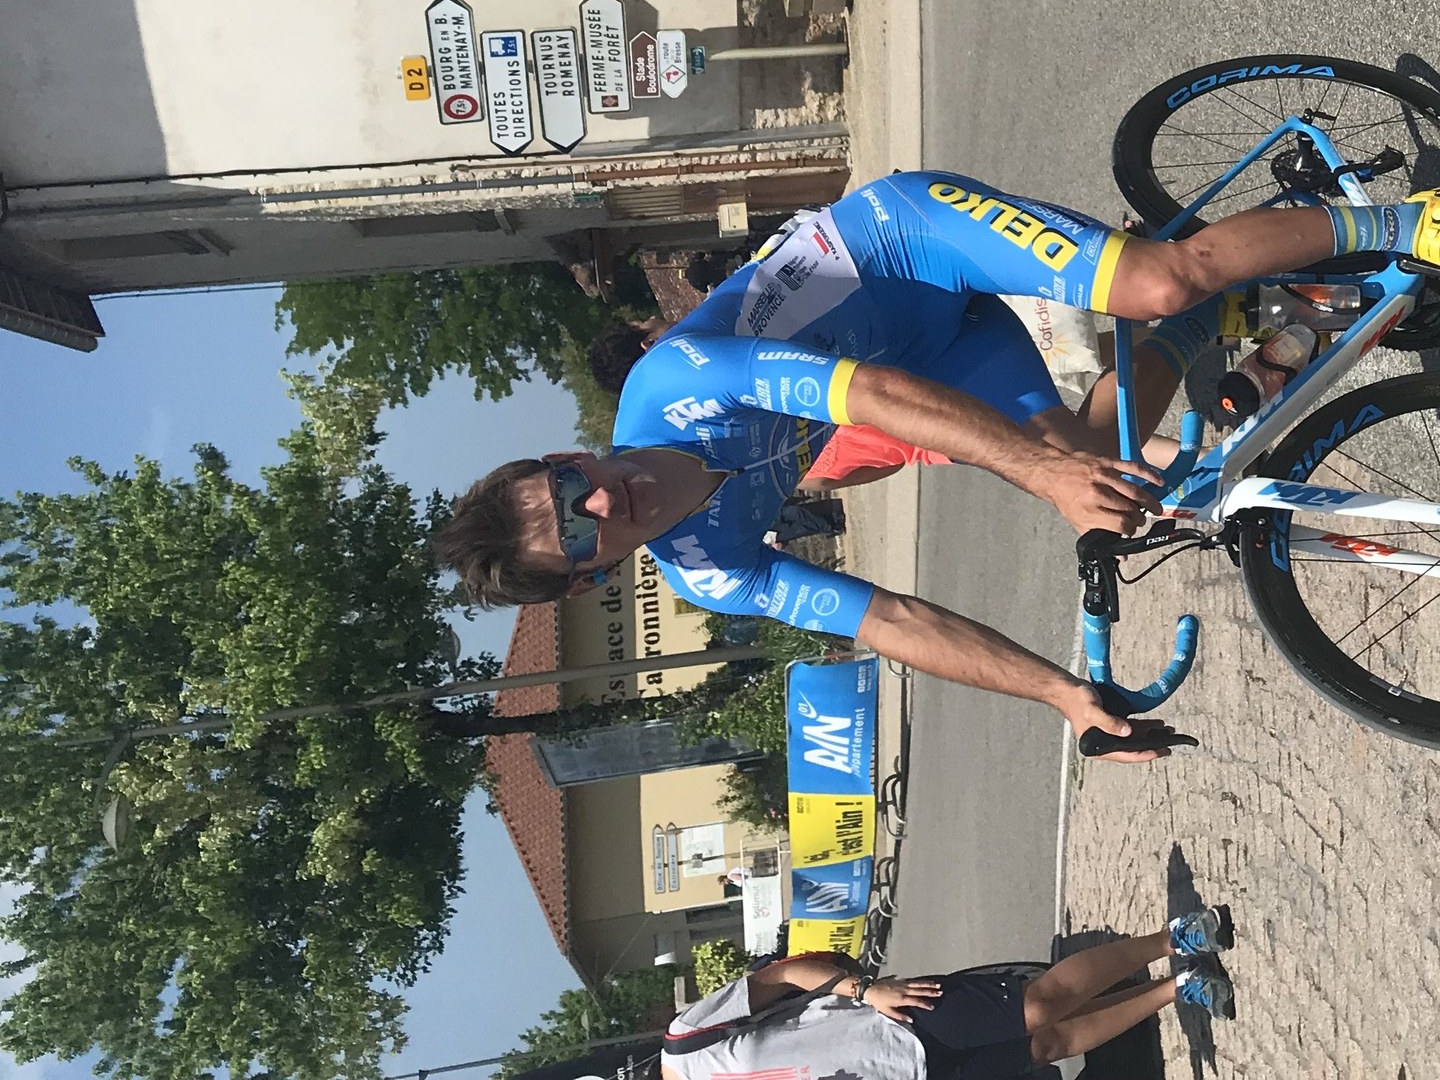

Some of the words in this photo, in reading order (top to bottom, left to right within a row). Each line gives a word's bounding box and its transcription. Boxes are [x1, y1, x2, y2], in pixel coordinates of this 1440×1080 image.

[434, 13, 448, 24] B.
[441, 30, 450, 41] EN
[452, 13, 473, 89] MANTENAY-M.
[539, 35, 558, 96] TOURNUS
[556, 35, 575, 96] ROMENAY
[586, 9, 606, 92] FERME-MUSÉE
[604, 25, 620, 62] FORÊT
[407, 68, 422, 76] 2
[409, 82, 424, 90] D
[438, 46, 456, 90] BOURG
[614, 69, 622, 78] LA
[615, 82, 623, 92] DE
[635, 57, 646, 82] Stade
[646, 44, 657, 93] Boulodrome
[1166, 64, 1336, 108] CORIMA
[494, 91, 509, 138] TOUTES
[507, 60, 526, 138] DIRECTIONS
[860, 188, 890, 221] poli
[928, 182, 1080, 272] DELKO
[747, 283, 774, 327] MARSEILLE
[1034, 298, 1054, 351] Cofidis
[669, 338, 710, 368] poli
[756, 351, 830, 364] SRAM
[780, 377, 788, 412] rovence
[671, 534, 742, 600] KTM
[600, 585, 622, 613] de
[634, 552, 663, 698] Caronnière
[601, 622, 626, 704] Esace
[802, 715, 852, 774] AIN
[836, 810, 863, 837] l'Ain
